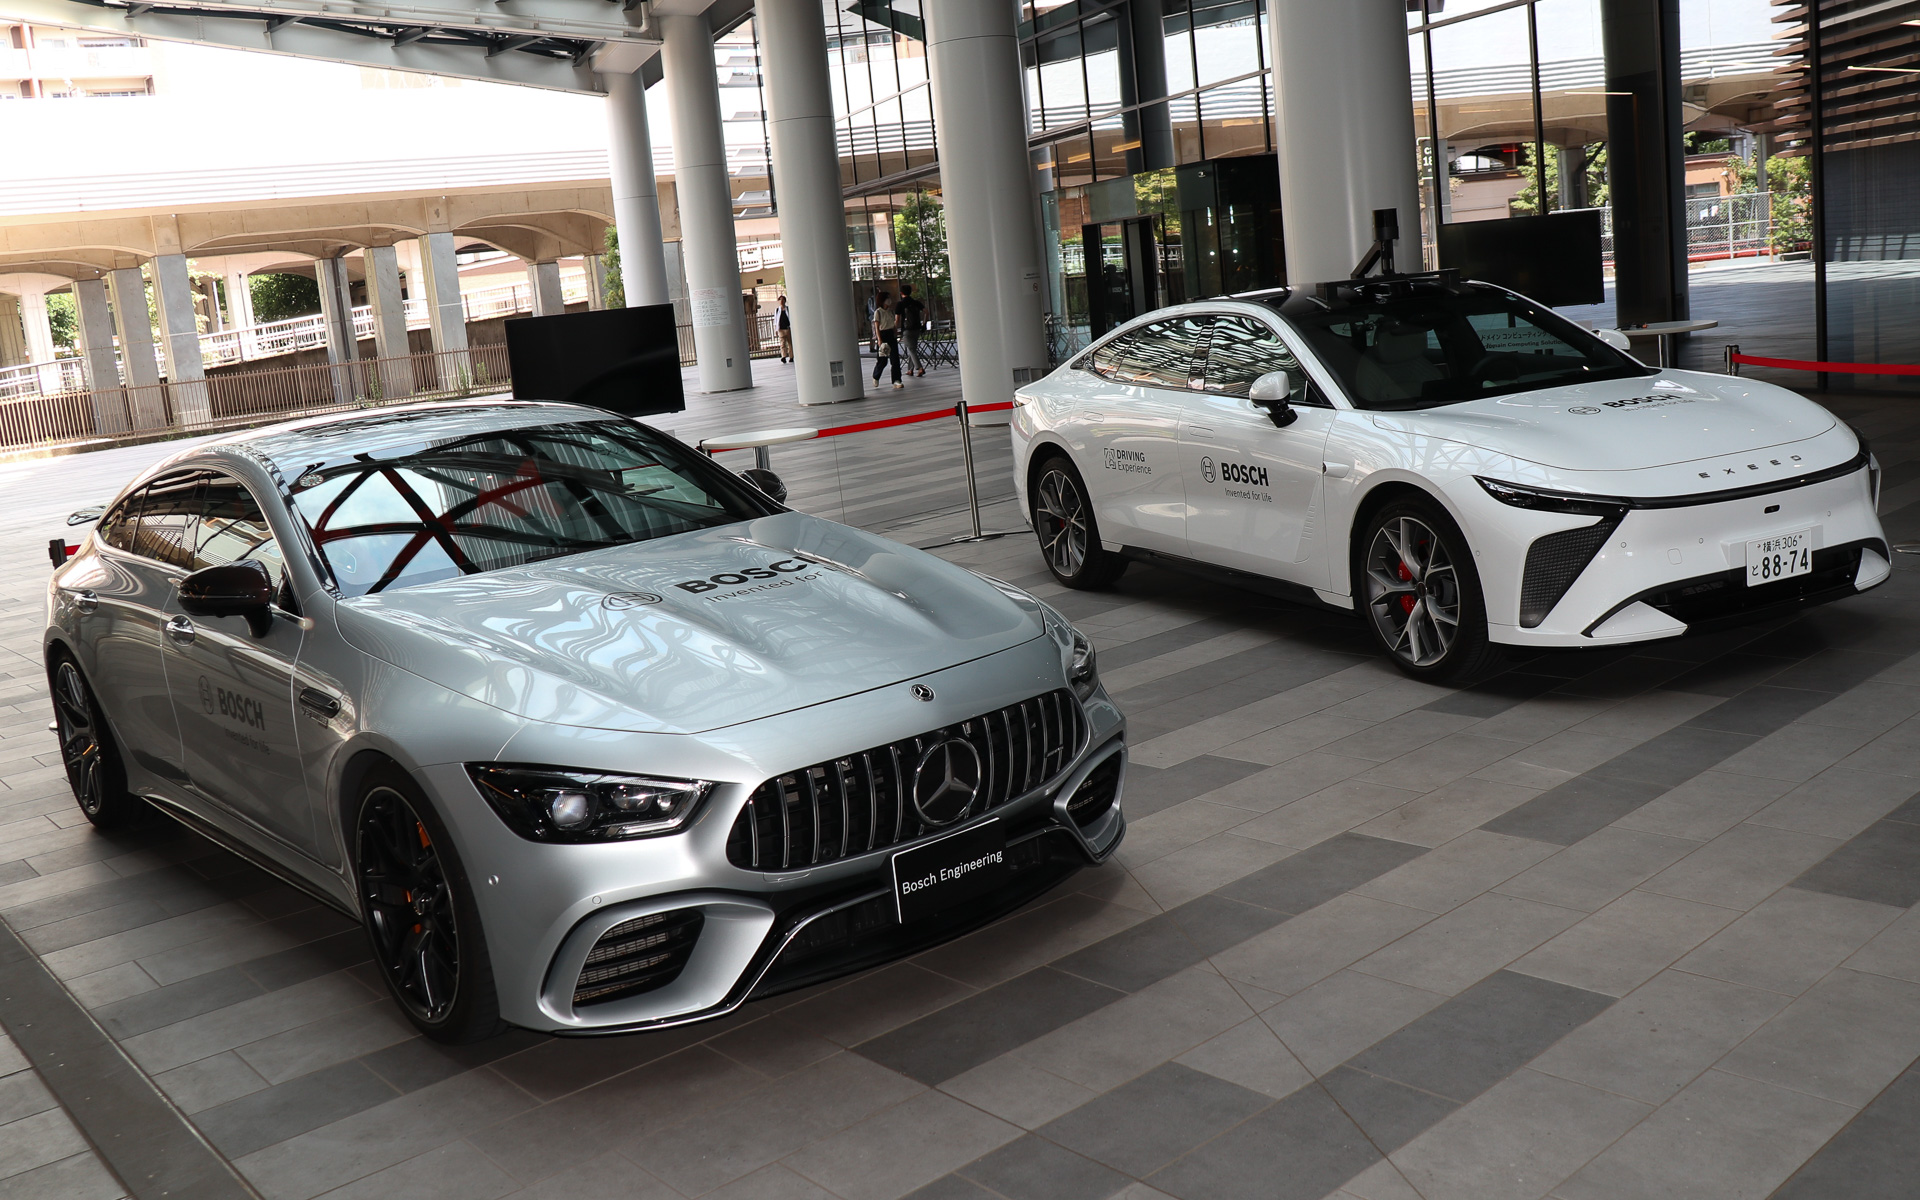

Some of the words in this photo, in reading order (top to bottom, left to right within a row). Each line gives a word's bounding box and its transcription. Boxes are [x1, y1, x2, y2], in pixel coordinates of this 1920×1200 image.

[1508, 340, 1539, 348] Computing
[1602, 394, 1682, 408] BOSCH
[1117, 450, 1145, 462] DRIVING
[1118, 461, 1152, 474] Experience
[1698, 455, 1802, 478] EXEED
[1221, 463, 1269, 486] BOSCH
[1225, 488, 1250, 499] Invented
[1252, 491, 1260, 500] for
[1261, 492, 1272, 502] life
[1762, 547, 1808, 579] 88-74
[705, 580, 794, 602] Invented
[795, 571, 823, 582] for
[217, 687, 265, 731] BOSCH
[902, 873, 937, 895] Bosch
[940, 851, 1003, 882] Engineering
